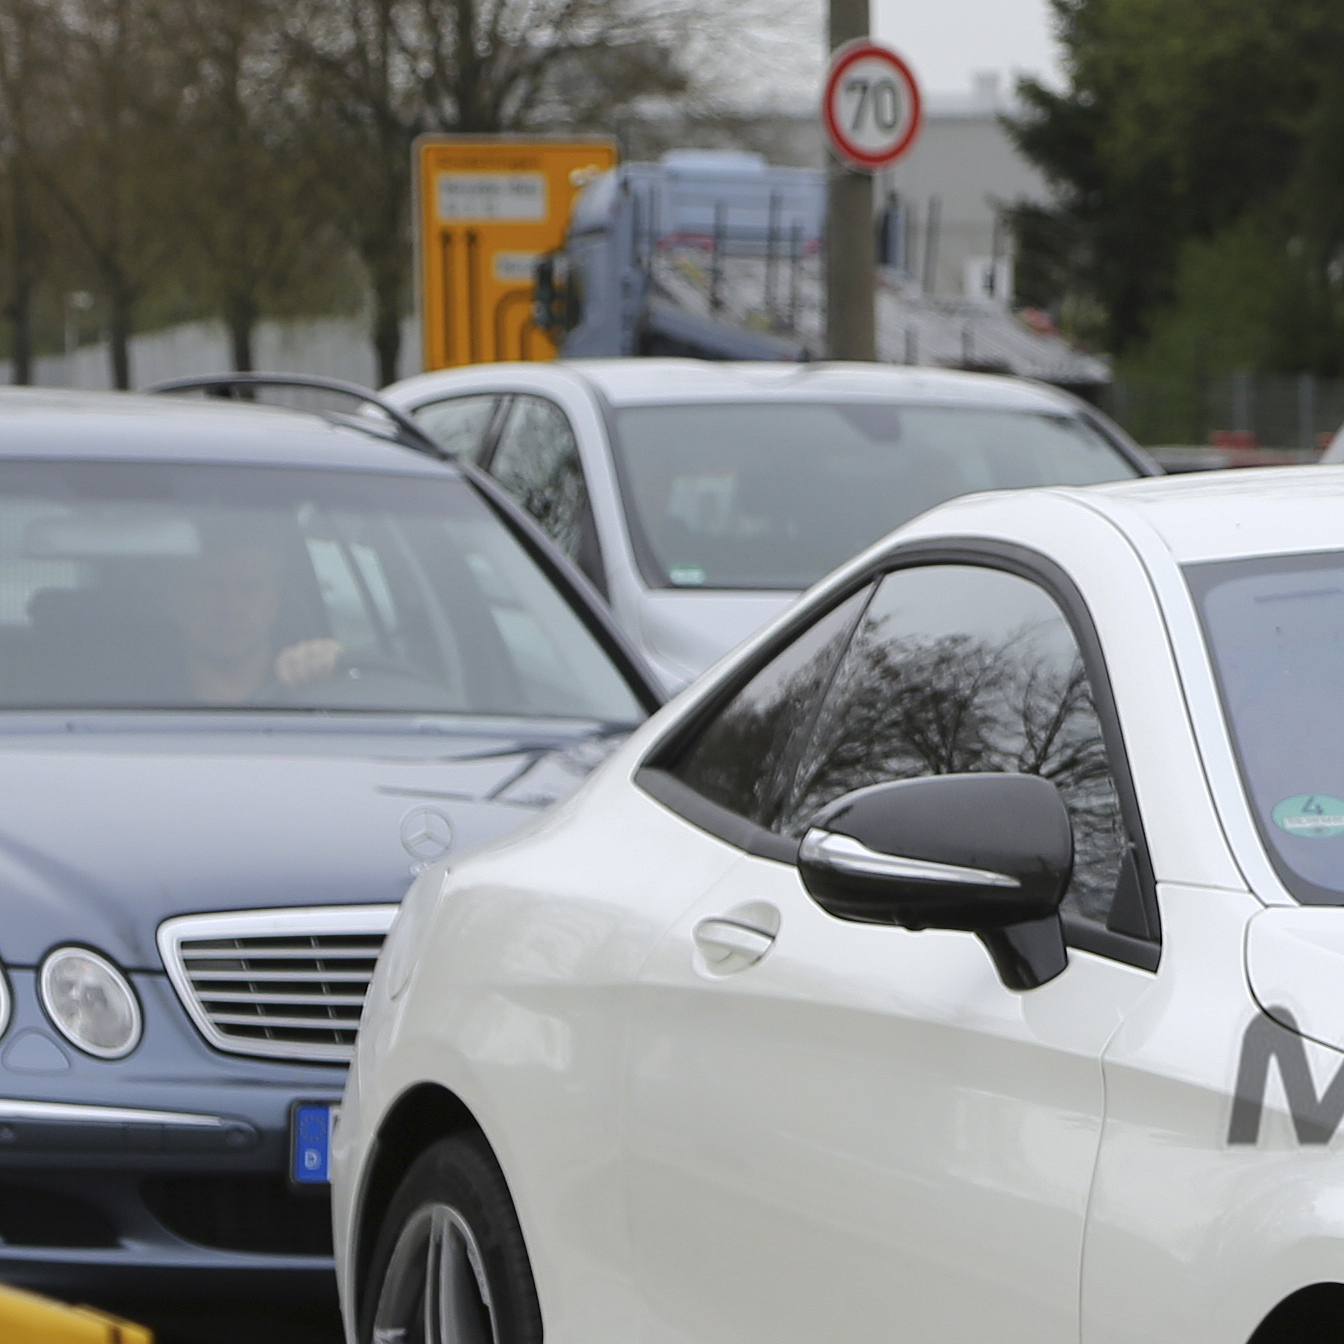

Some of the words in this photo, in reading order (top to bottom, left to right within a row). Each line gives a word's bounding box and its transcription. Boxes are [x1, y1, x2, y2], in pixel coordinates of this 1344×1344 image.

[844, 77, 900, 134] 70
[1302, 796, 1324, 815] 4
[304, 1148, 321, 1171] D
